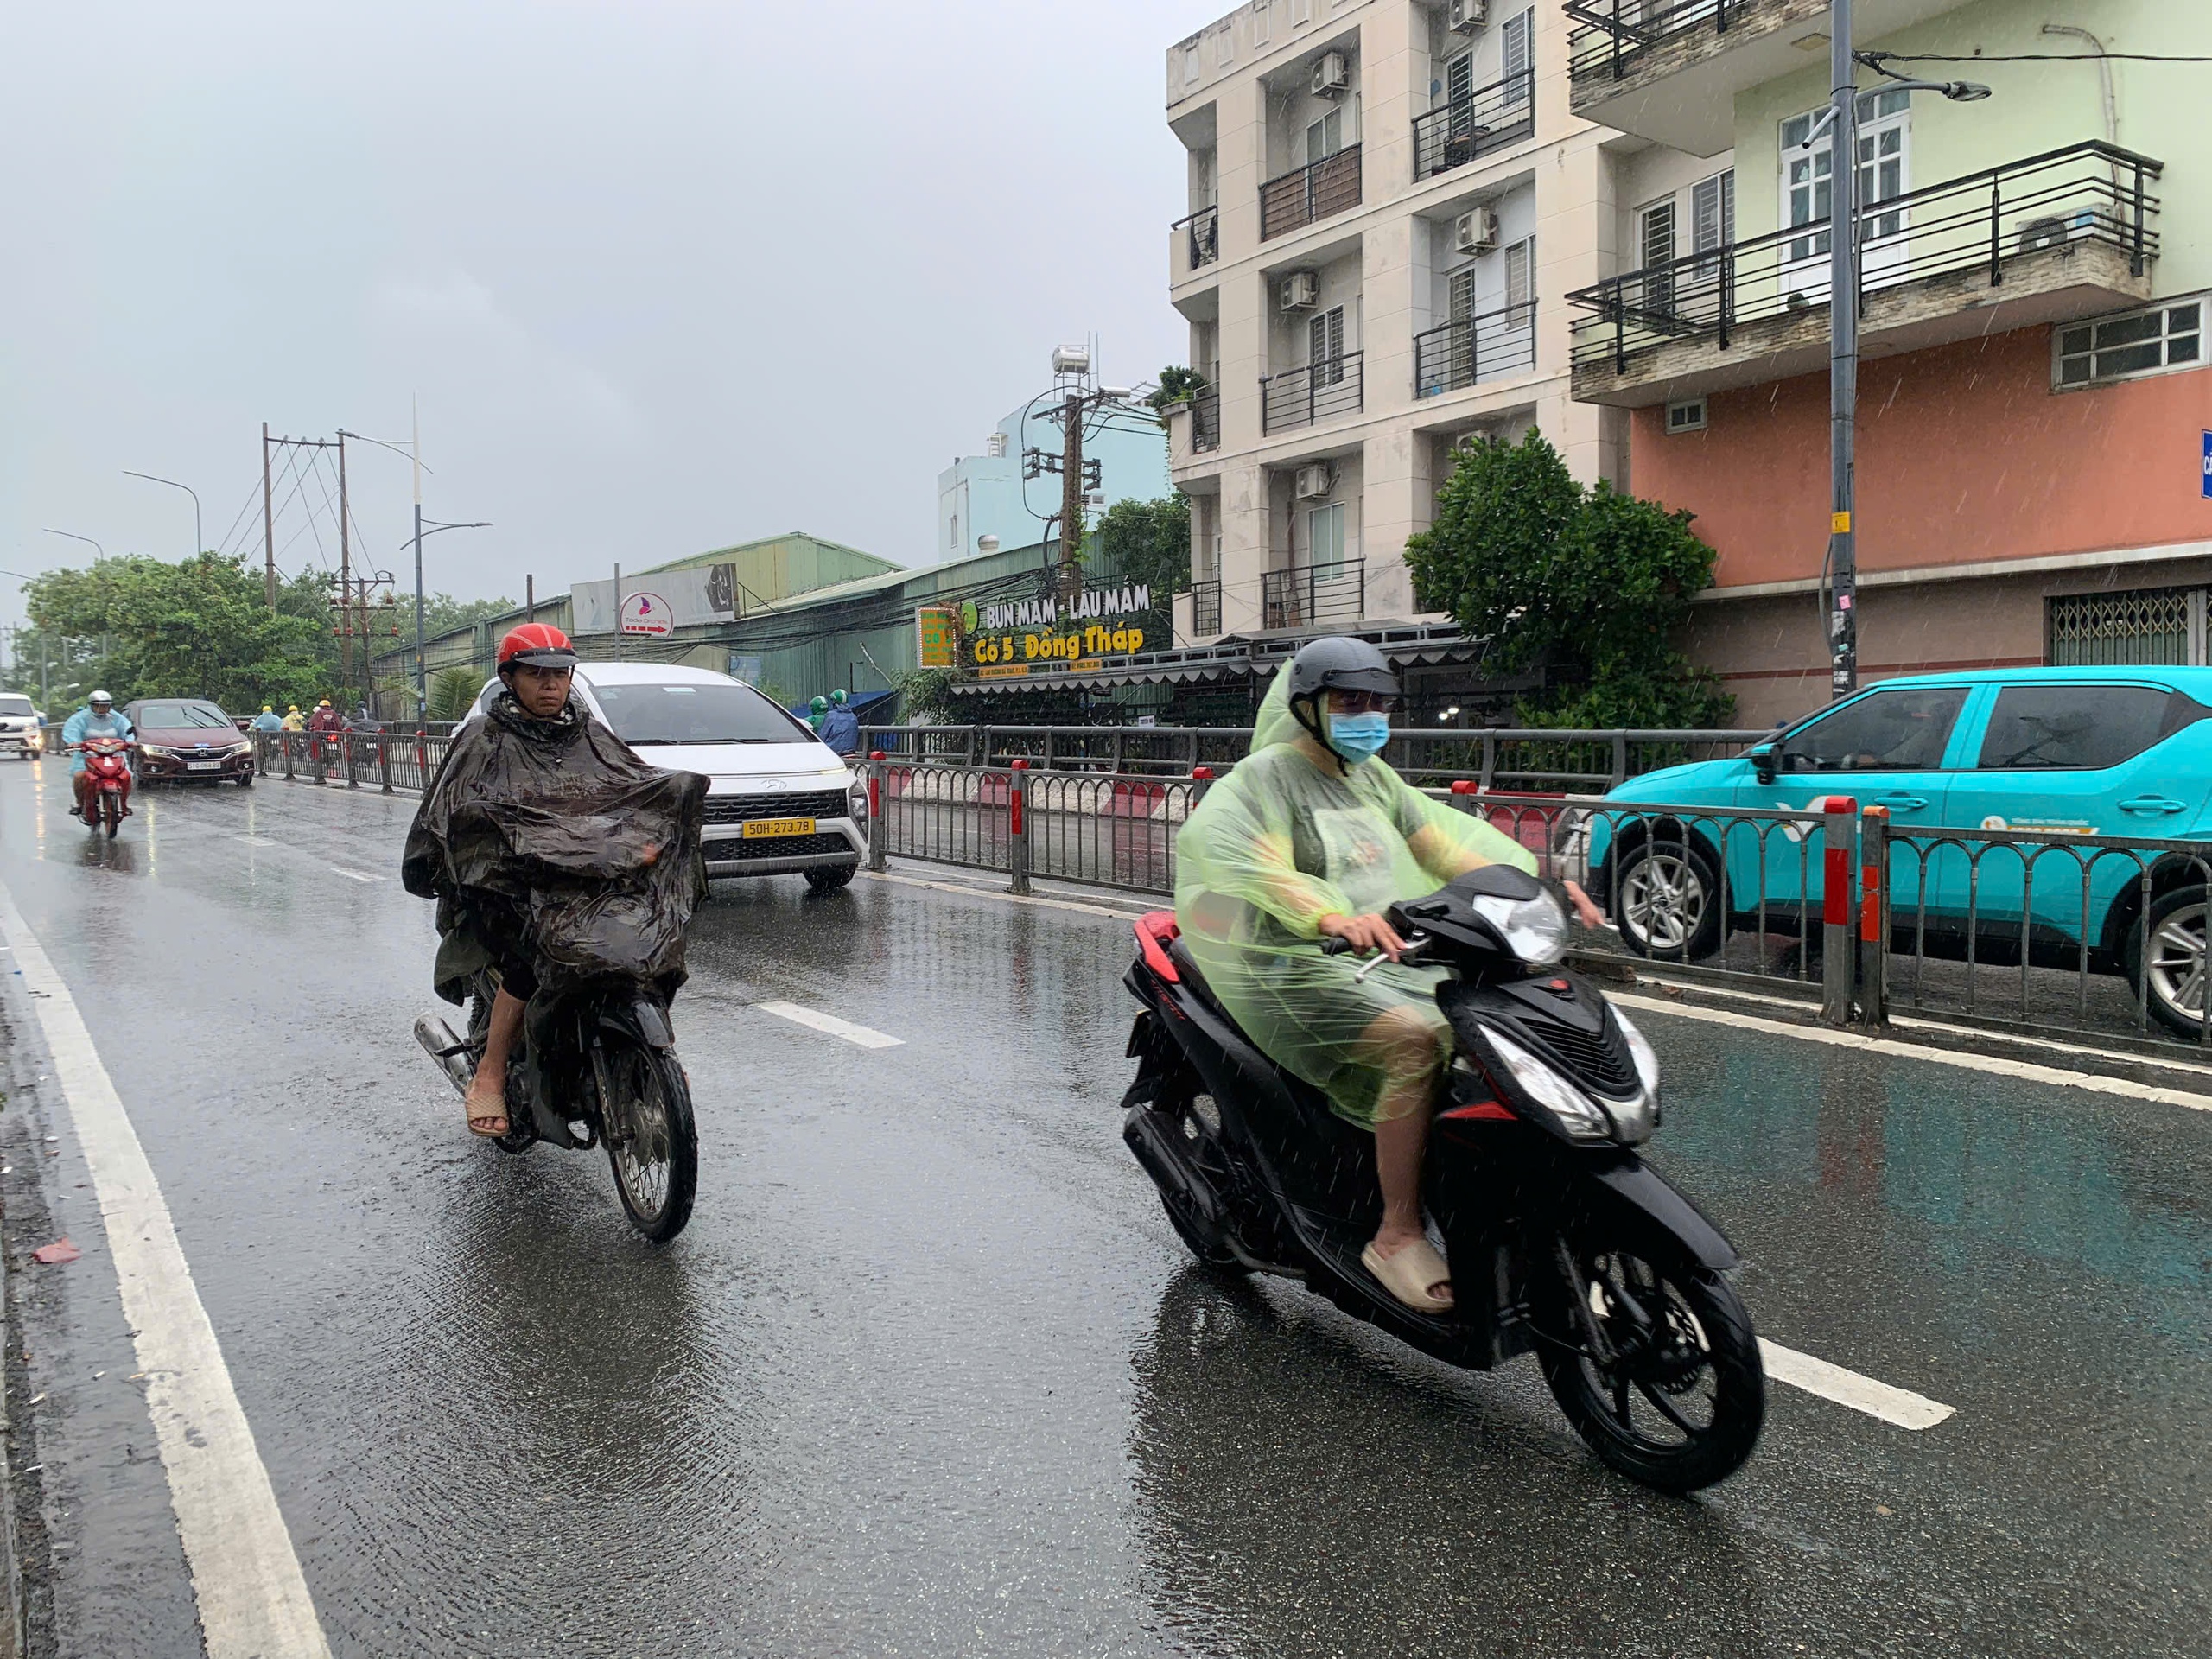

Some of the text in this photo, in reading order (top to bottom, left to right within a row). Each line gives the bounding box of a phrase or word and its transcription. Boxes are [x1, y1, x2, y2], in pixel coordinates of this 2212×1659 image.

[987, 595, 1014, 629] BÚN
[1016, 588, 1057, 626] MẮM
[1070, 580, 1101, 620] LẨU
[1105, 574, 1150, 616] MẮM
[975, 620, 1143, 663] Cô 5 Đồng Tháp
[749, 821, 810, 835] 50H-273.78
